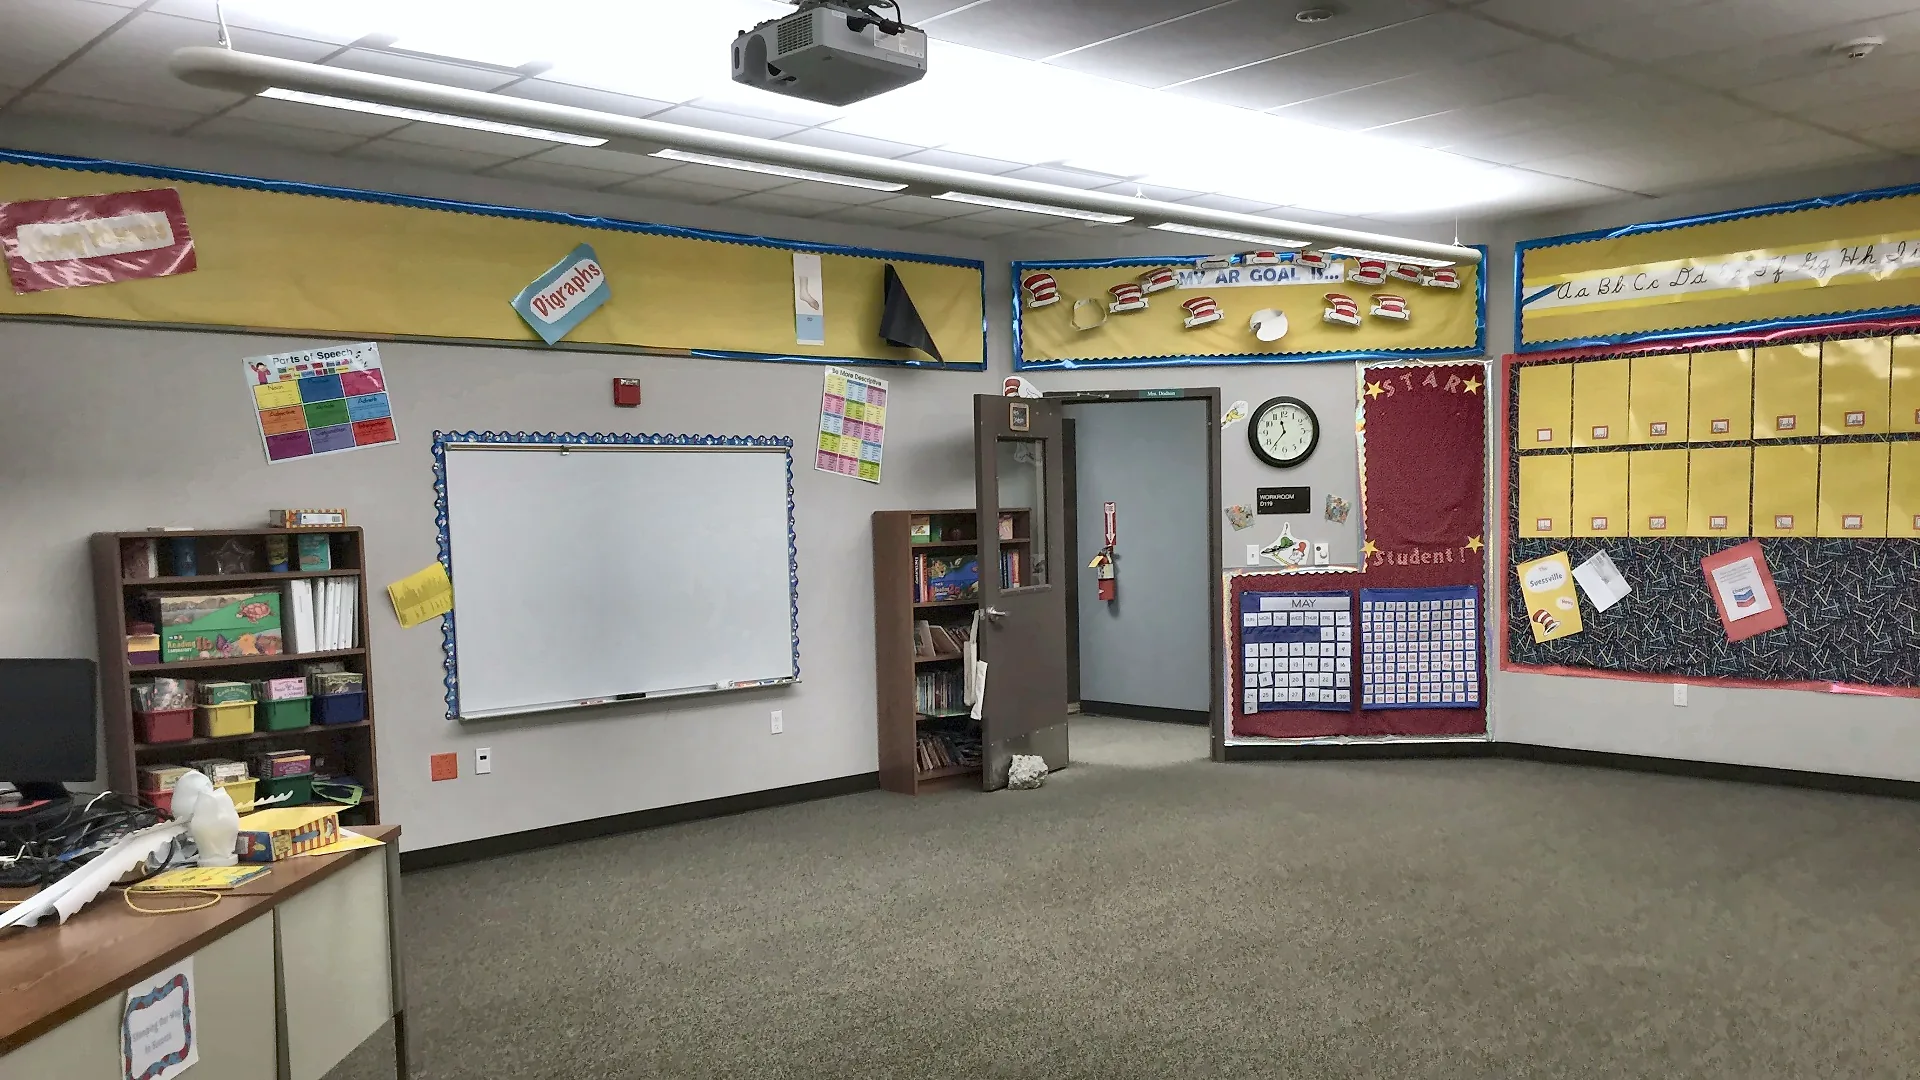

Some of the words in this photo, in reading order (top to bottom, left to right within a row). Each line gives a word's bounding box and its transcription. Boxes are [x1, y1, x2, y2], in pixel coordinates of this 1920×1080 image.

[1180, 271, 1205, 285] MY
[1216, 270, 1240, 284] AR
[1250, 268, 1300, 282] GOAL
[1598, 275, 1624, 295] Bb
[1634, 273, 1660, 290] Cc
[1670, 266, 1707, 286] Dd
[1840, 244, 1876, 267] Hh
[533, 264, 600, 316] Digraphs
[273, 355, 300, 364] Parts
[304, 352, 313, 362] of
[316, 348, 353, 360] Speech
[1383, 370, 1460, 398] STAR
[1373, 547, 1453, 566] Student
[1460, 547, 1465, 564] !
[1292, 599, 1316, 608] MAY
